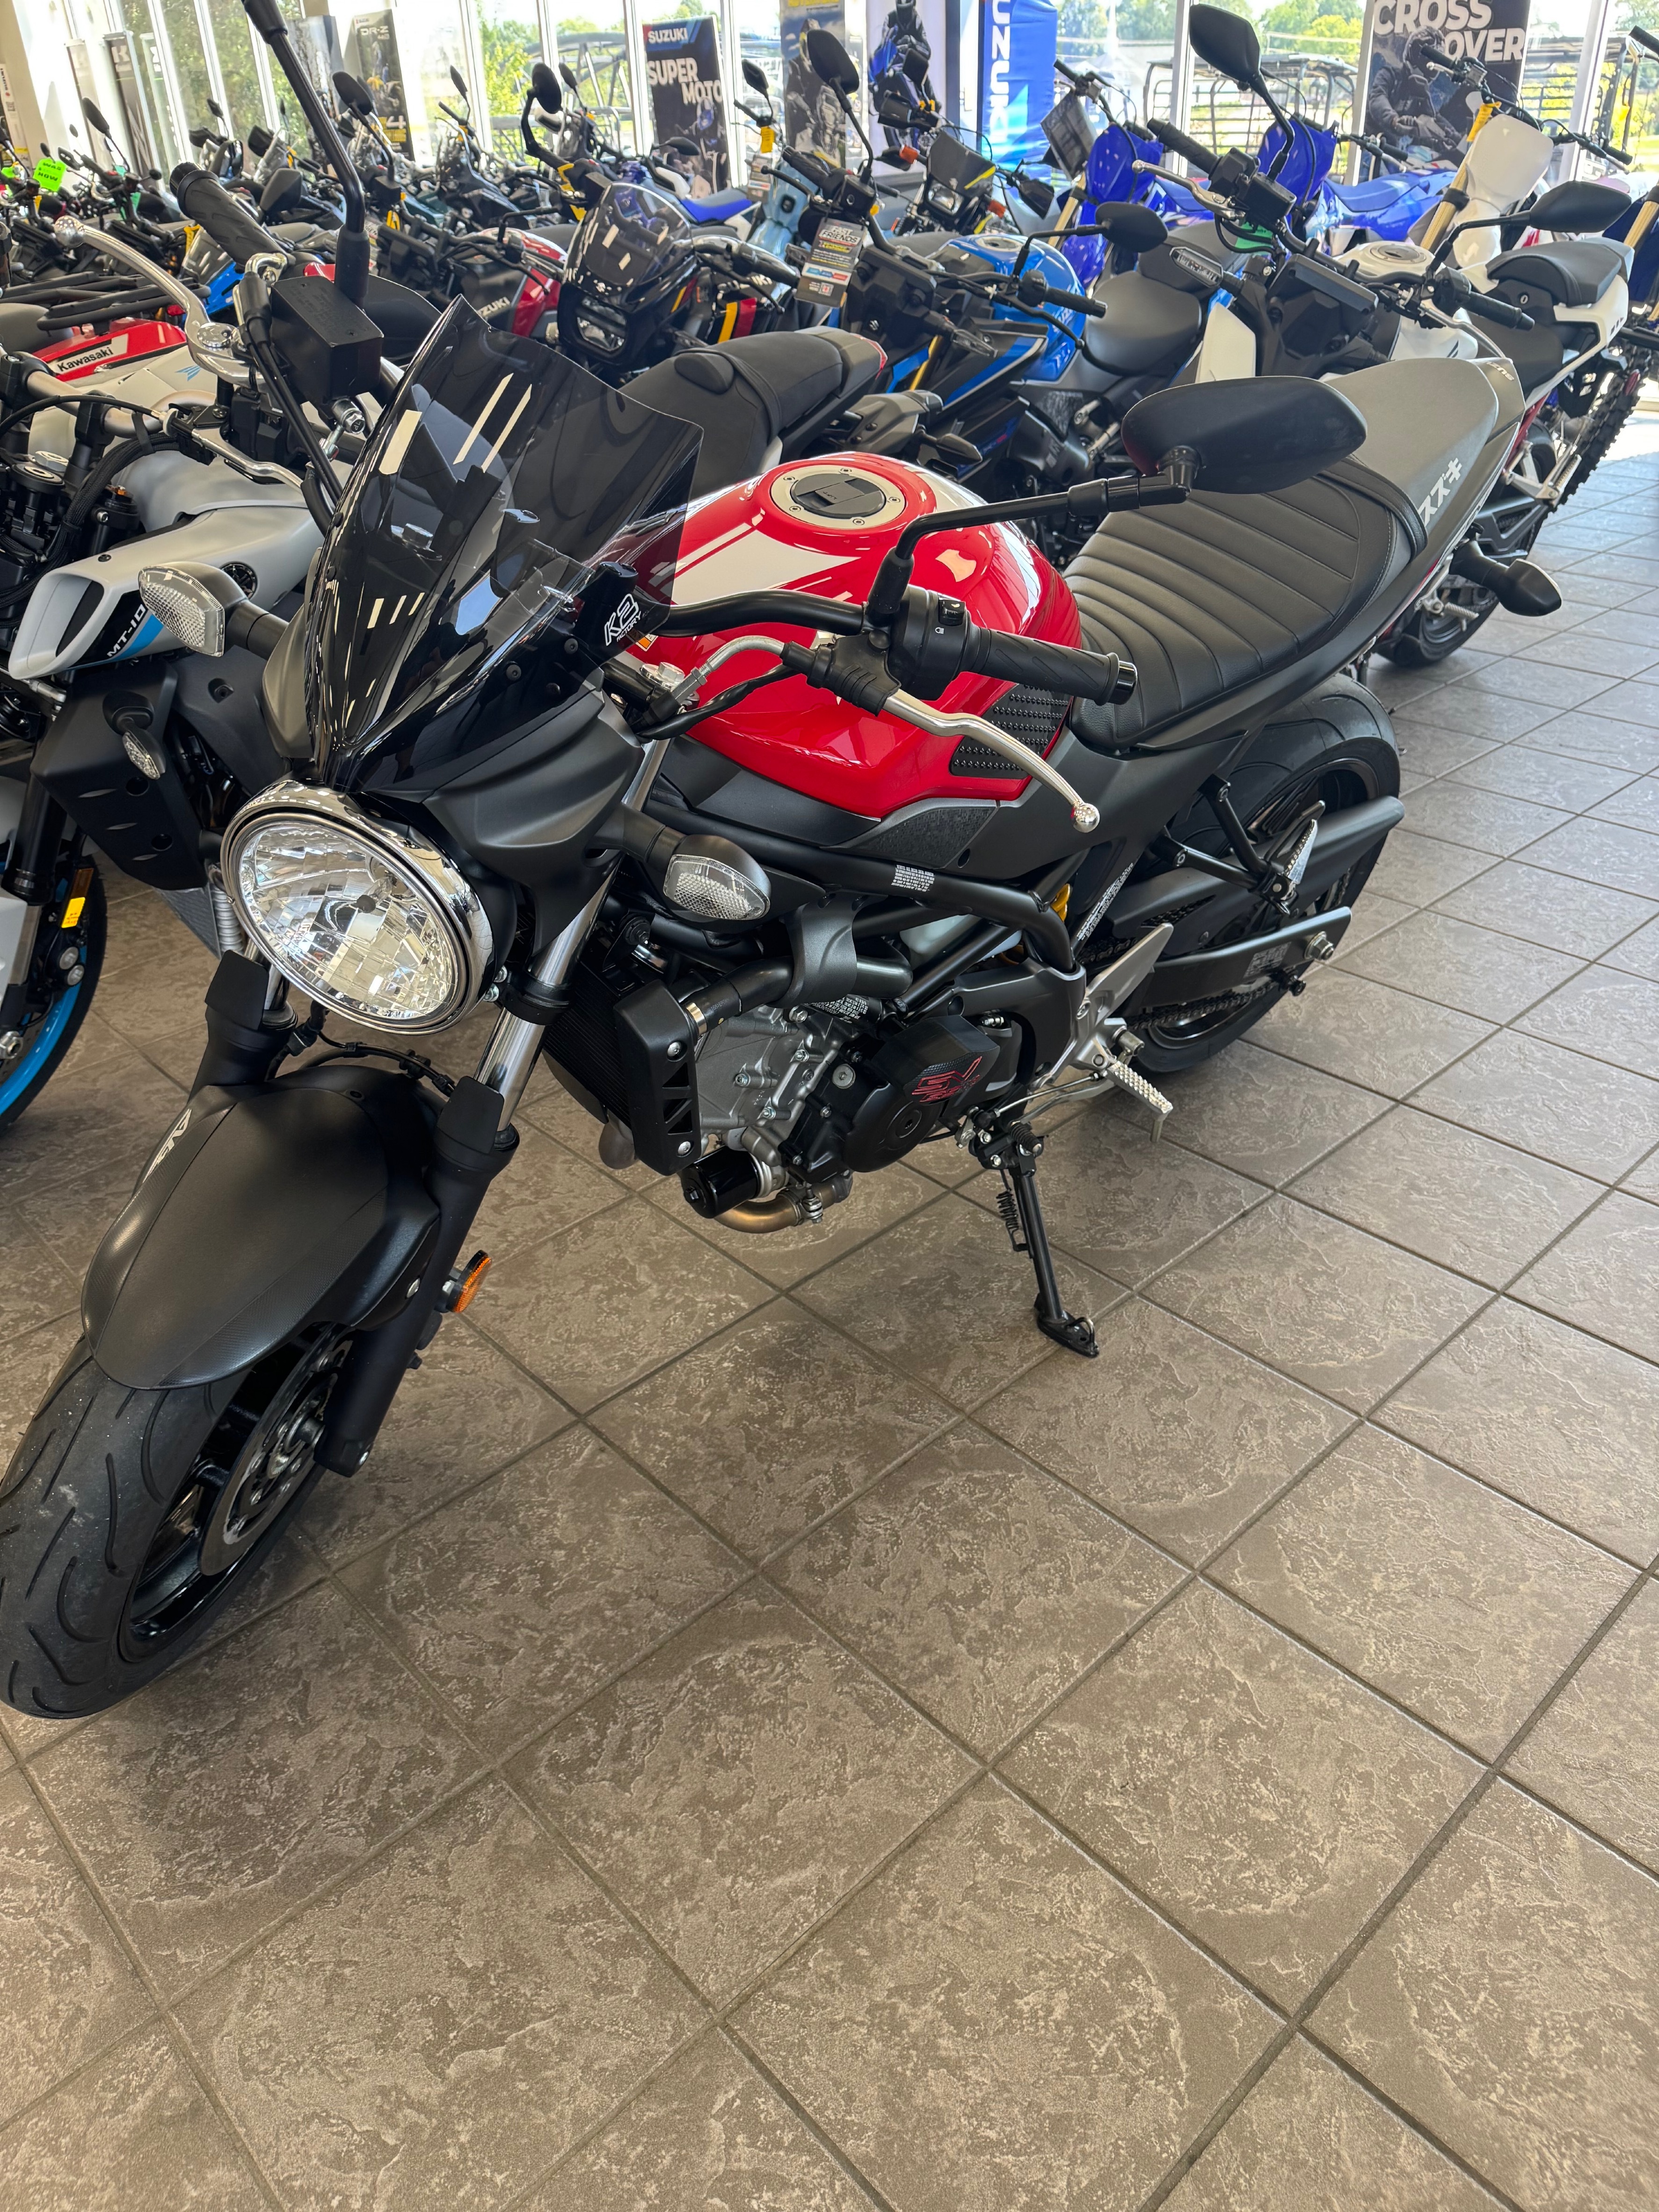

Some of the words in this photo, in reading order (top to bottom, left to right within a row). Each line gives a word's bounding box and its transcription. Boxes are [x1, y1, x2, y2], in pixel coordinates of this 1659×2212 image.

[1373, 0, 1492, 35] CROSS
[648, 27, 689, 44] SUZUKI
[1444, 28, 1526, 64] OVER
[647, 57, 699, 86] SUPER
[681, 80, 722, 106] MOTO
[822, 231, 858, 243] FRIENDS
[57, 346, 114, 372] Kawasaki
[107, 603, 146, 657] MT-10
[604, 593, 639, 646] K2
[616, 610, 641, 642] FACTORY
